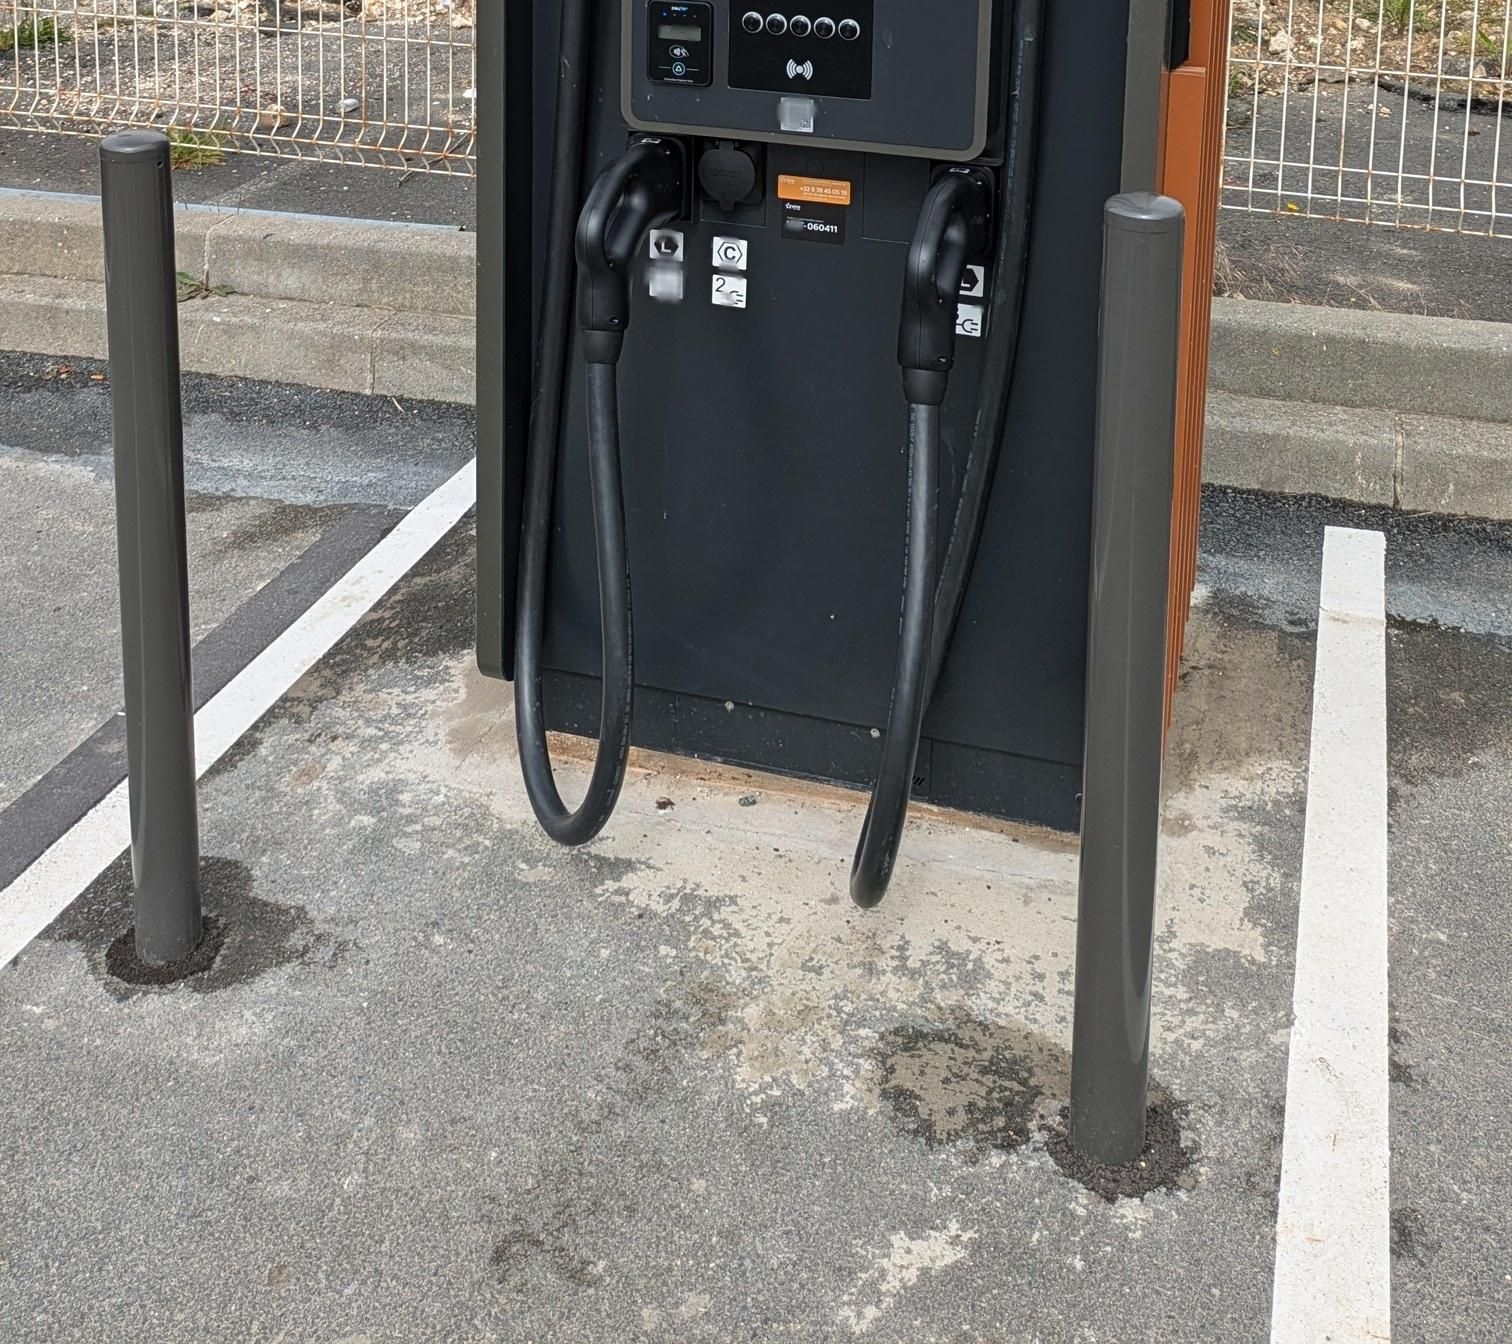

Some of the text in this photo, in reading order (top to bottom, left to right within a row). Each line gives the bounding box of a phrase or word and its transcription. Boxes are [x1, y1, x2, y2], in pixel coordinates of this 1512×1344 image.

[661, 242, 672, 252] L
[724, 246, 736, 260] C
[715, 277, 726, 292] 2
